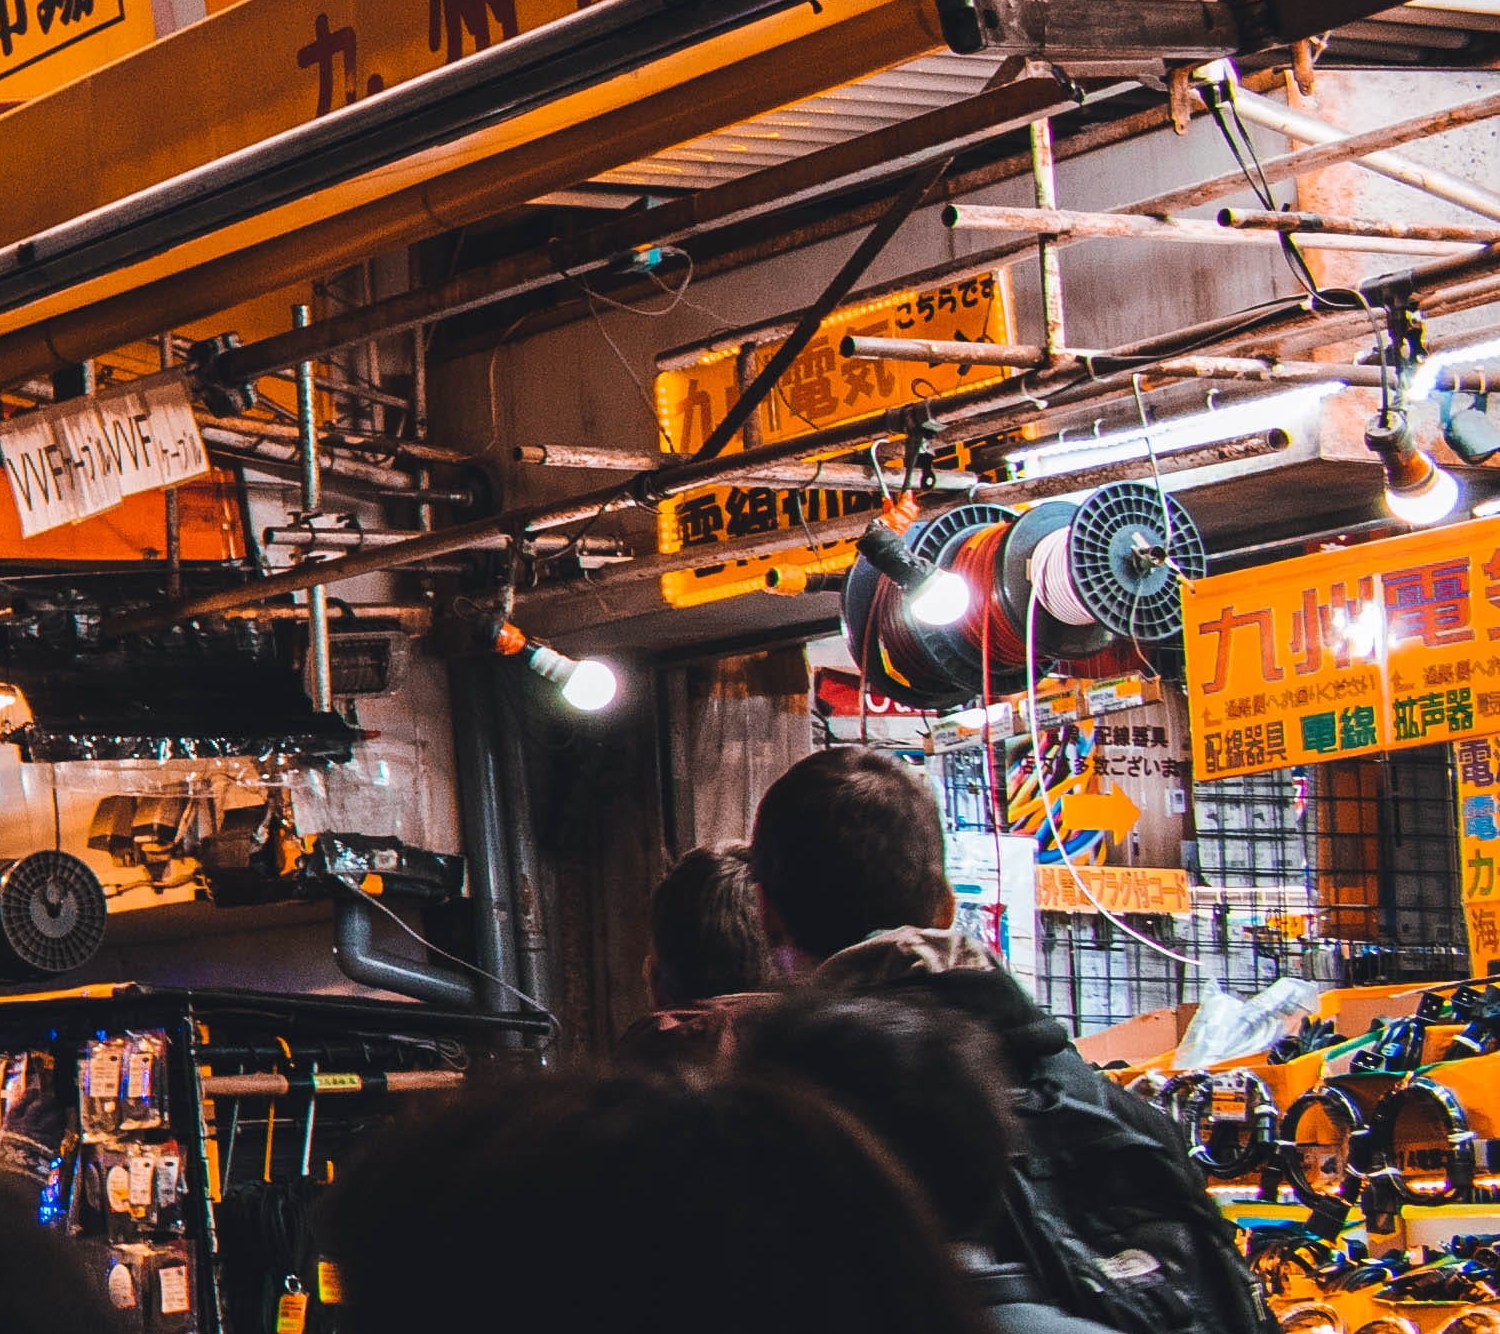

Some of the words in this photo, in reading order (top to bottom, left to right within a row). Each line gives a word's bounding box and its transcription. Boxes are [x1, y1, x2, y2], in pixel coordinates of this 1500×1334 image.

[895, 272, 994, 329] こちらです
[1199, 547, 1500, 695] 九州電
[1301, 705, 1377, 755] 電線
[1394, 687, 1474, 742] 拡声器
[1204, 721, 1288, 775] 配線器具
